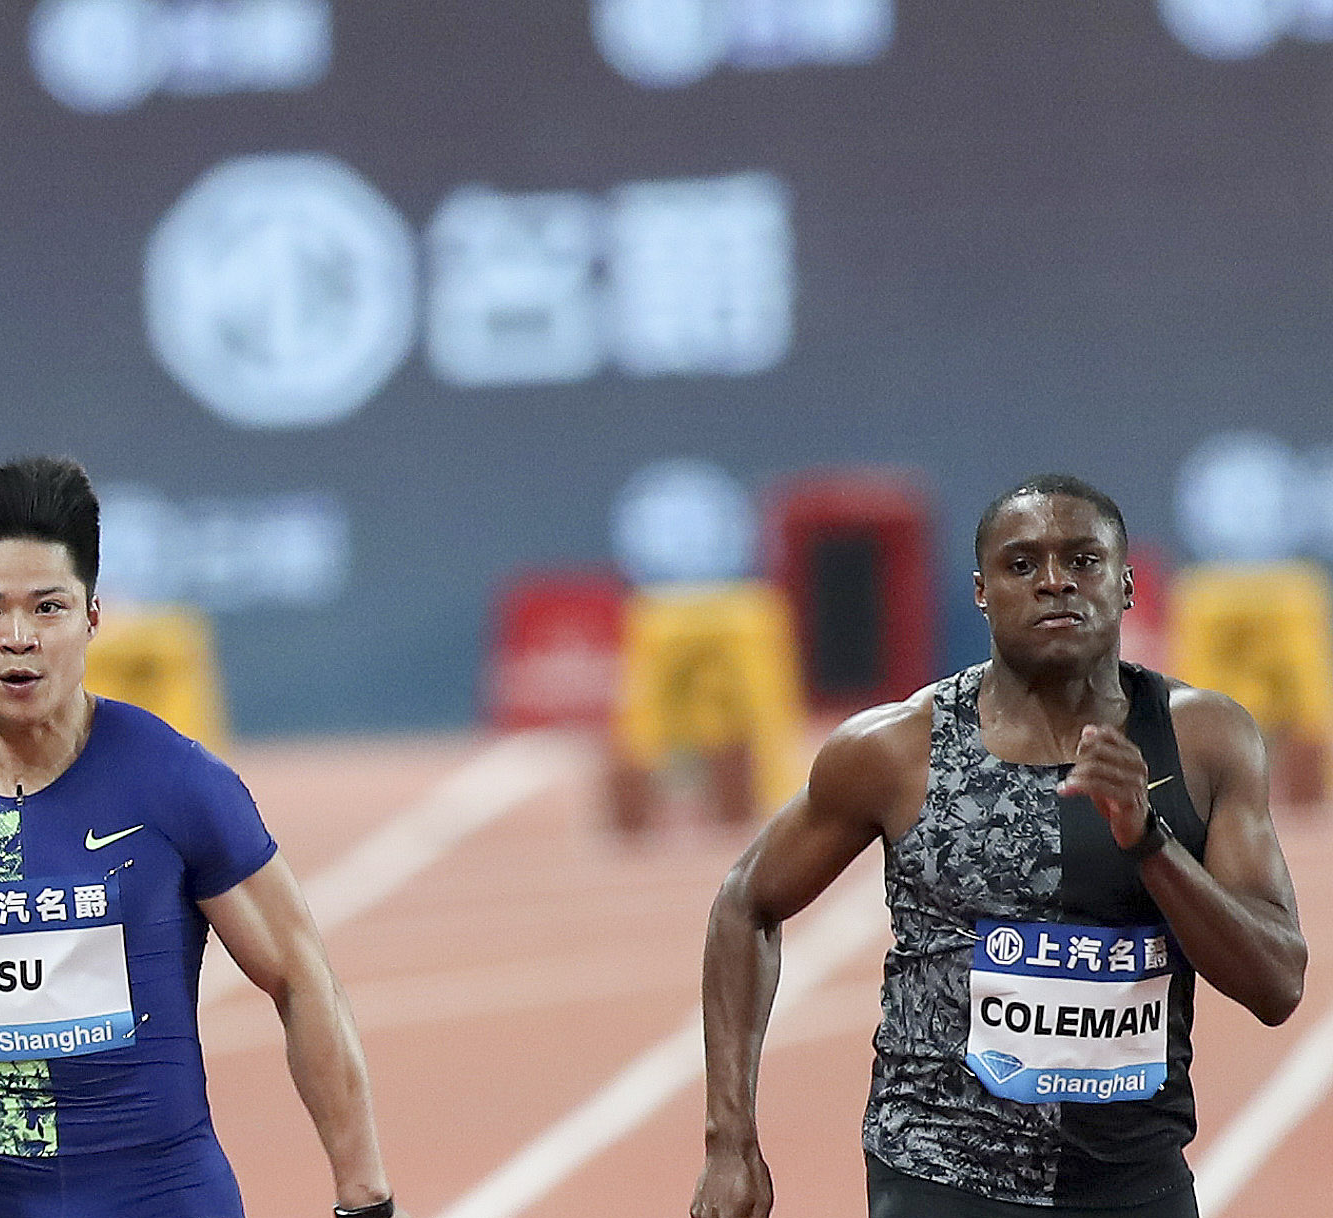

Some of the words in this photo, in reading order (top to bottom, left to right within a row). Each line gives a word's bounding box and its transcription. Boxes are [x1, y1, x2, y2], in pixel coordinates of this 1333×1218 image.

[1026, 933, 1168, 972] 上汽名爵
[981, 997, 1161, 1038] COLEMAN
[1036, 1070, 1146, 1099] Shanghai
